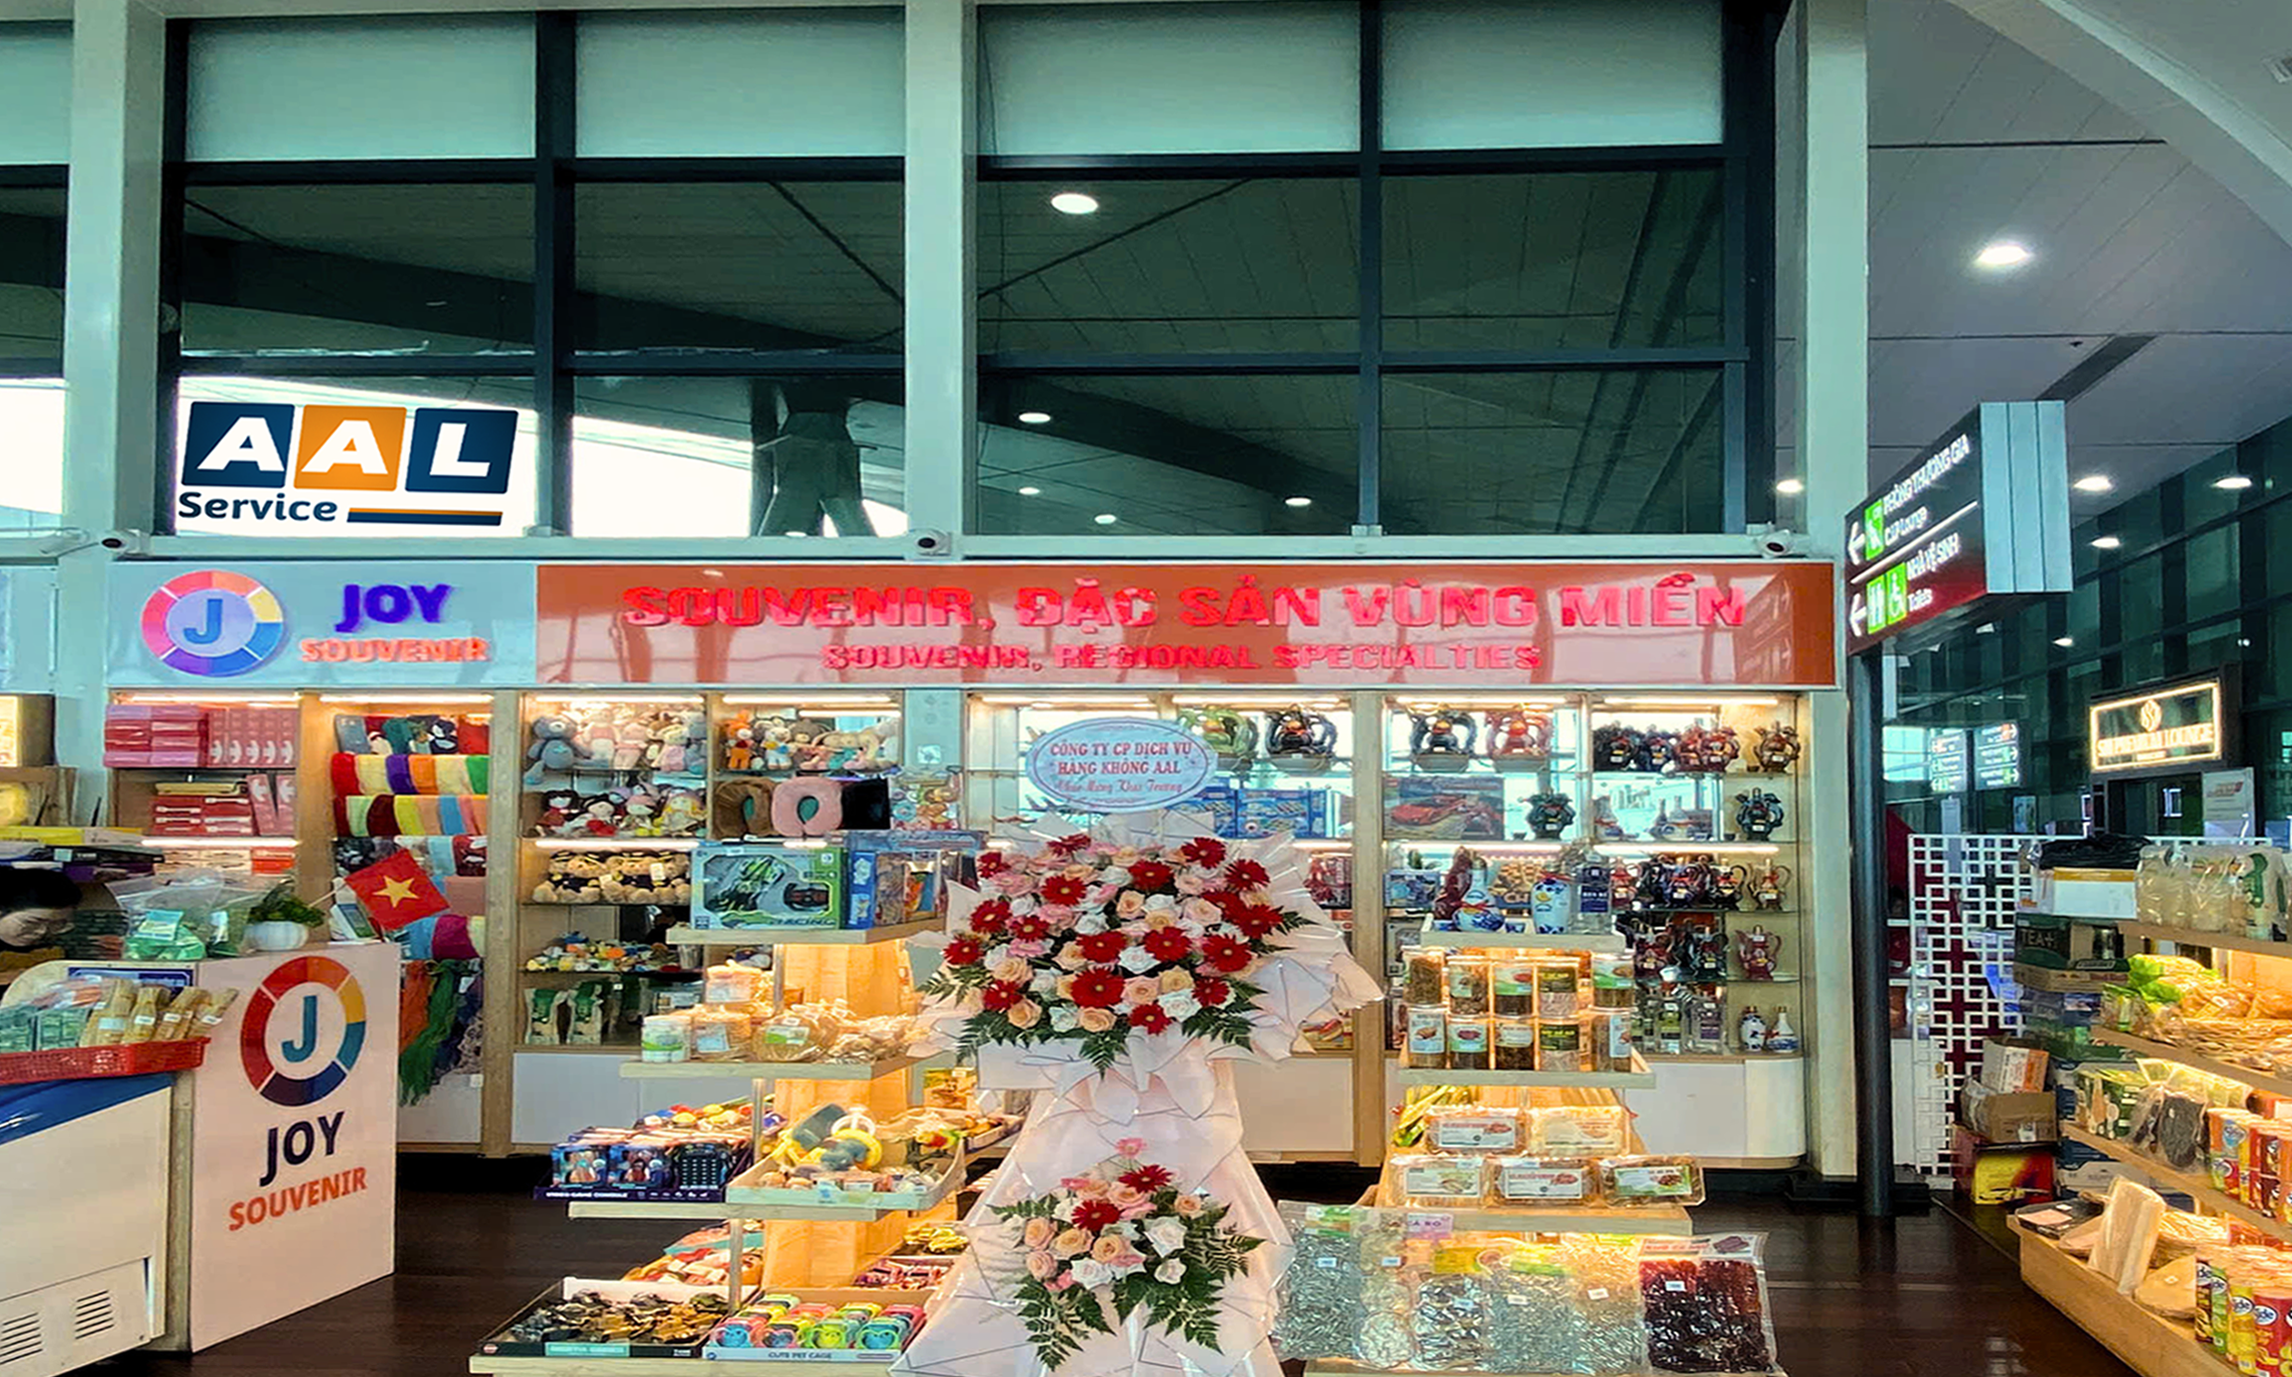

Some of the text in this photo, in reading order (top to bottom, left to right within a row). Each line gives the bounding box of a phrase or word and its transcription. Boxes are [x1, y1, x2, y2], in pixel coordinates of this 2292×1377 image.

[197, 416, 491, 477] AAL
[179, 492, 338, 521] Service
[184, 598, 223, 644] J
[335, 583, 452, 633] JOY
[622, 586, 996, 630] SOUVENIR,
[1342, 578, 1538, 628] VÙNG
[300, 637, 489, 663] SOUVENIR
[823, 643, 1543, 672] SOUVENIR, REGIONAL SPECIALTIES
[1050, 739, 1088, 756] CÔNG
[1093, 743, 1108, 756] TY
[1113, 743, 1131, 756] CP
[1153, 760, 1181, 774] AAL
[281, 995, 317, 1063] J
[259, 1110, 345, 1187] JOY
[228, 1166, 367, 1232] SOUVENIR
